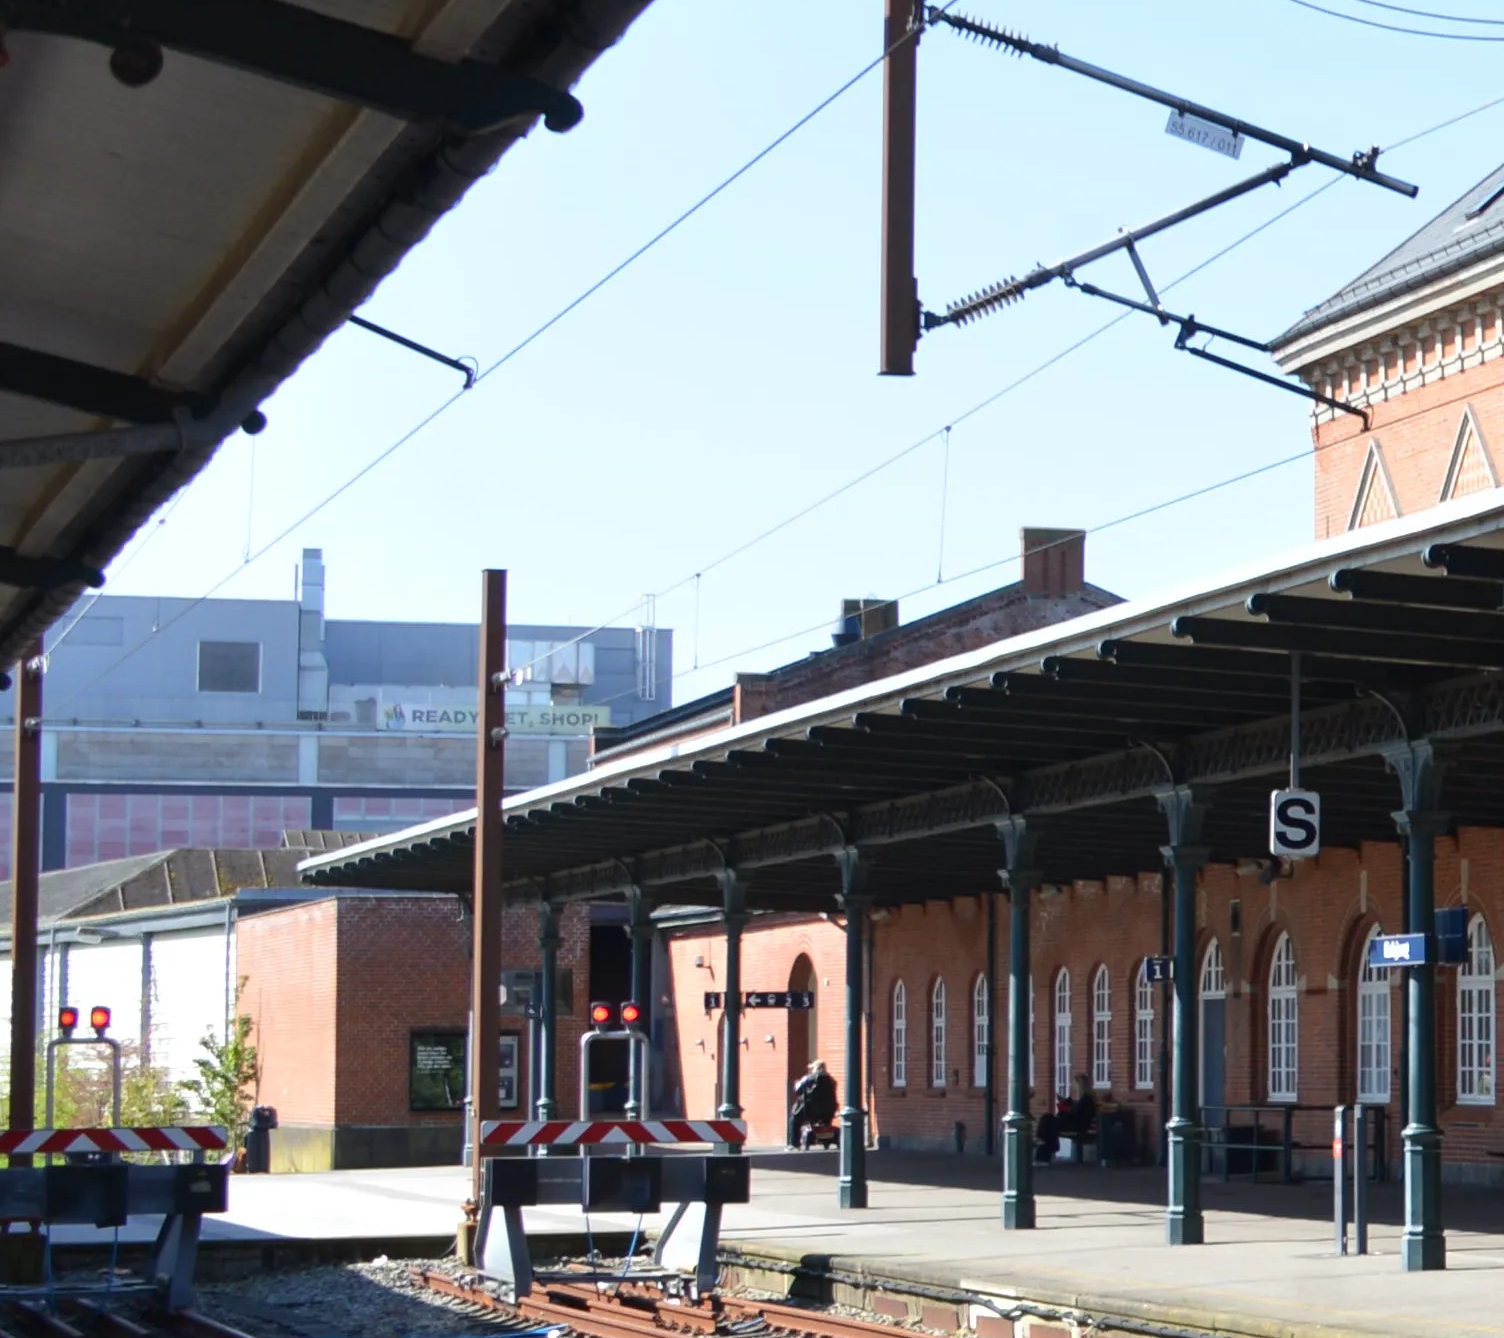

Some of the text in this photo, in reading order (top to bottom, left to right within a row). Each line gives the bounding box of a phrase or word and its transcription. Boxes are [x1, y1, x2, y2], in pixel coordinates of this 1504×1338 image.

[412, 709, 478, 724] READY
[539, 713, 599, 726] SHOP!
[1276, 797, 1317, 850] S
[1153, 964, 1163, 979] 1
